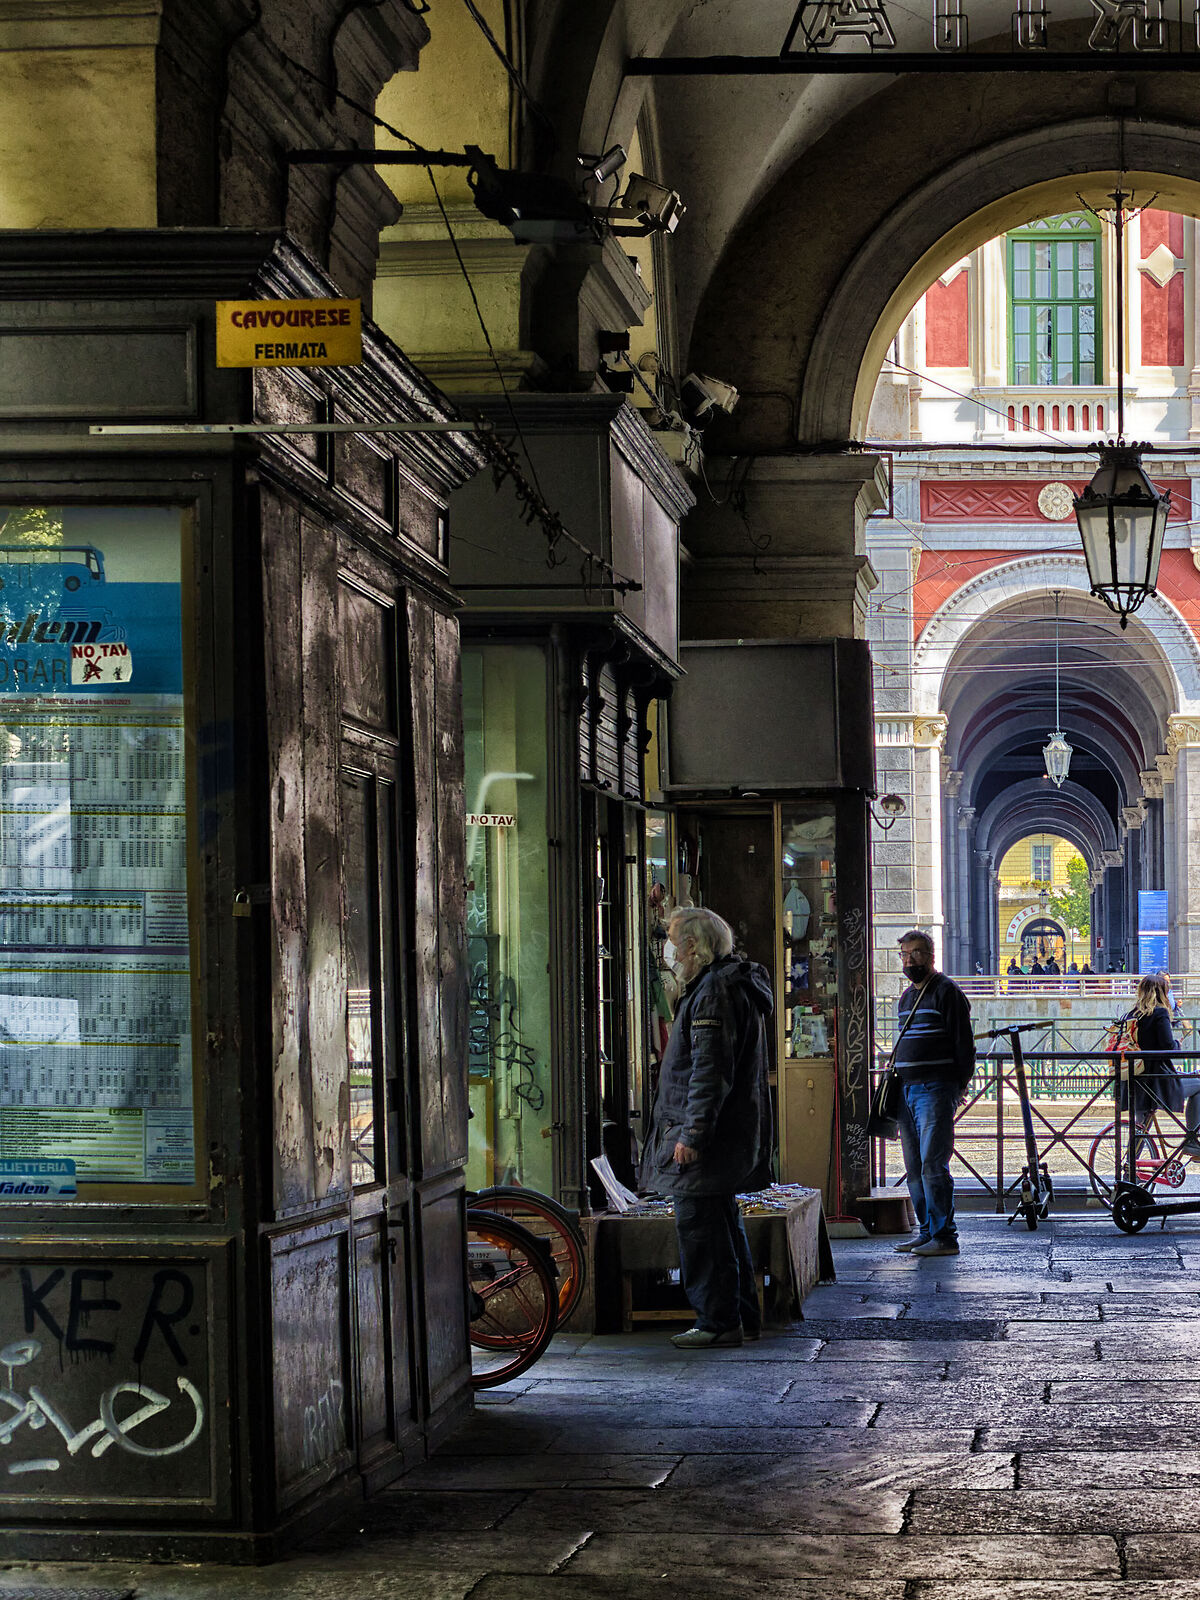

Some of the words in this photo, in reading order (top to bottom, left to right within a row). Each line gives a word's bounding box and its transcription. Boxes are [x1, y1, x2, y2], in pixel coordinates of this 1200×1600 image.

[231, 309, 351, 330] CAVOURESE
[255, 342, 328, 360] FERMATA
[71, 645, 95, 659] NO
[100, 644, 128, 657] TAV
[470, 815, 488, 825] NO
[491, 815, 513, 826] TAV
[1007, 905, 1036, 939] HOTEL
